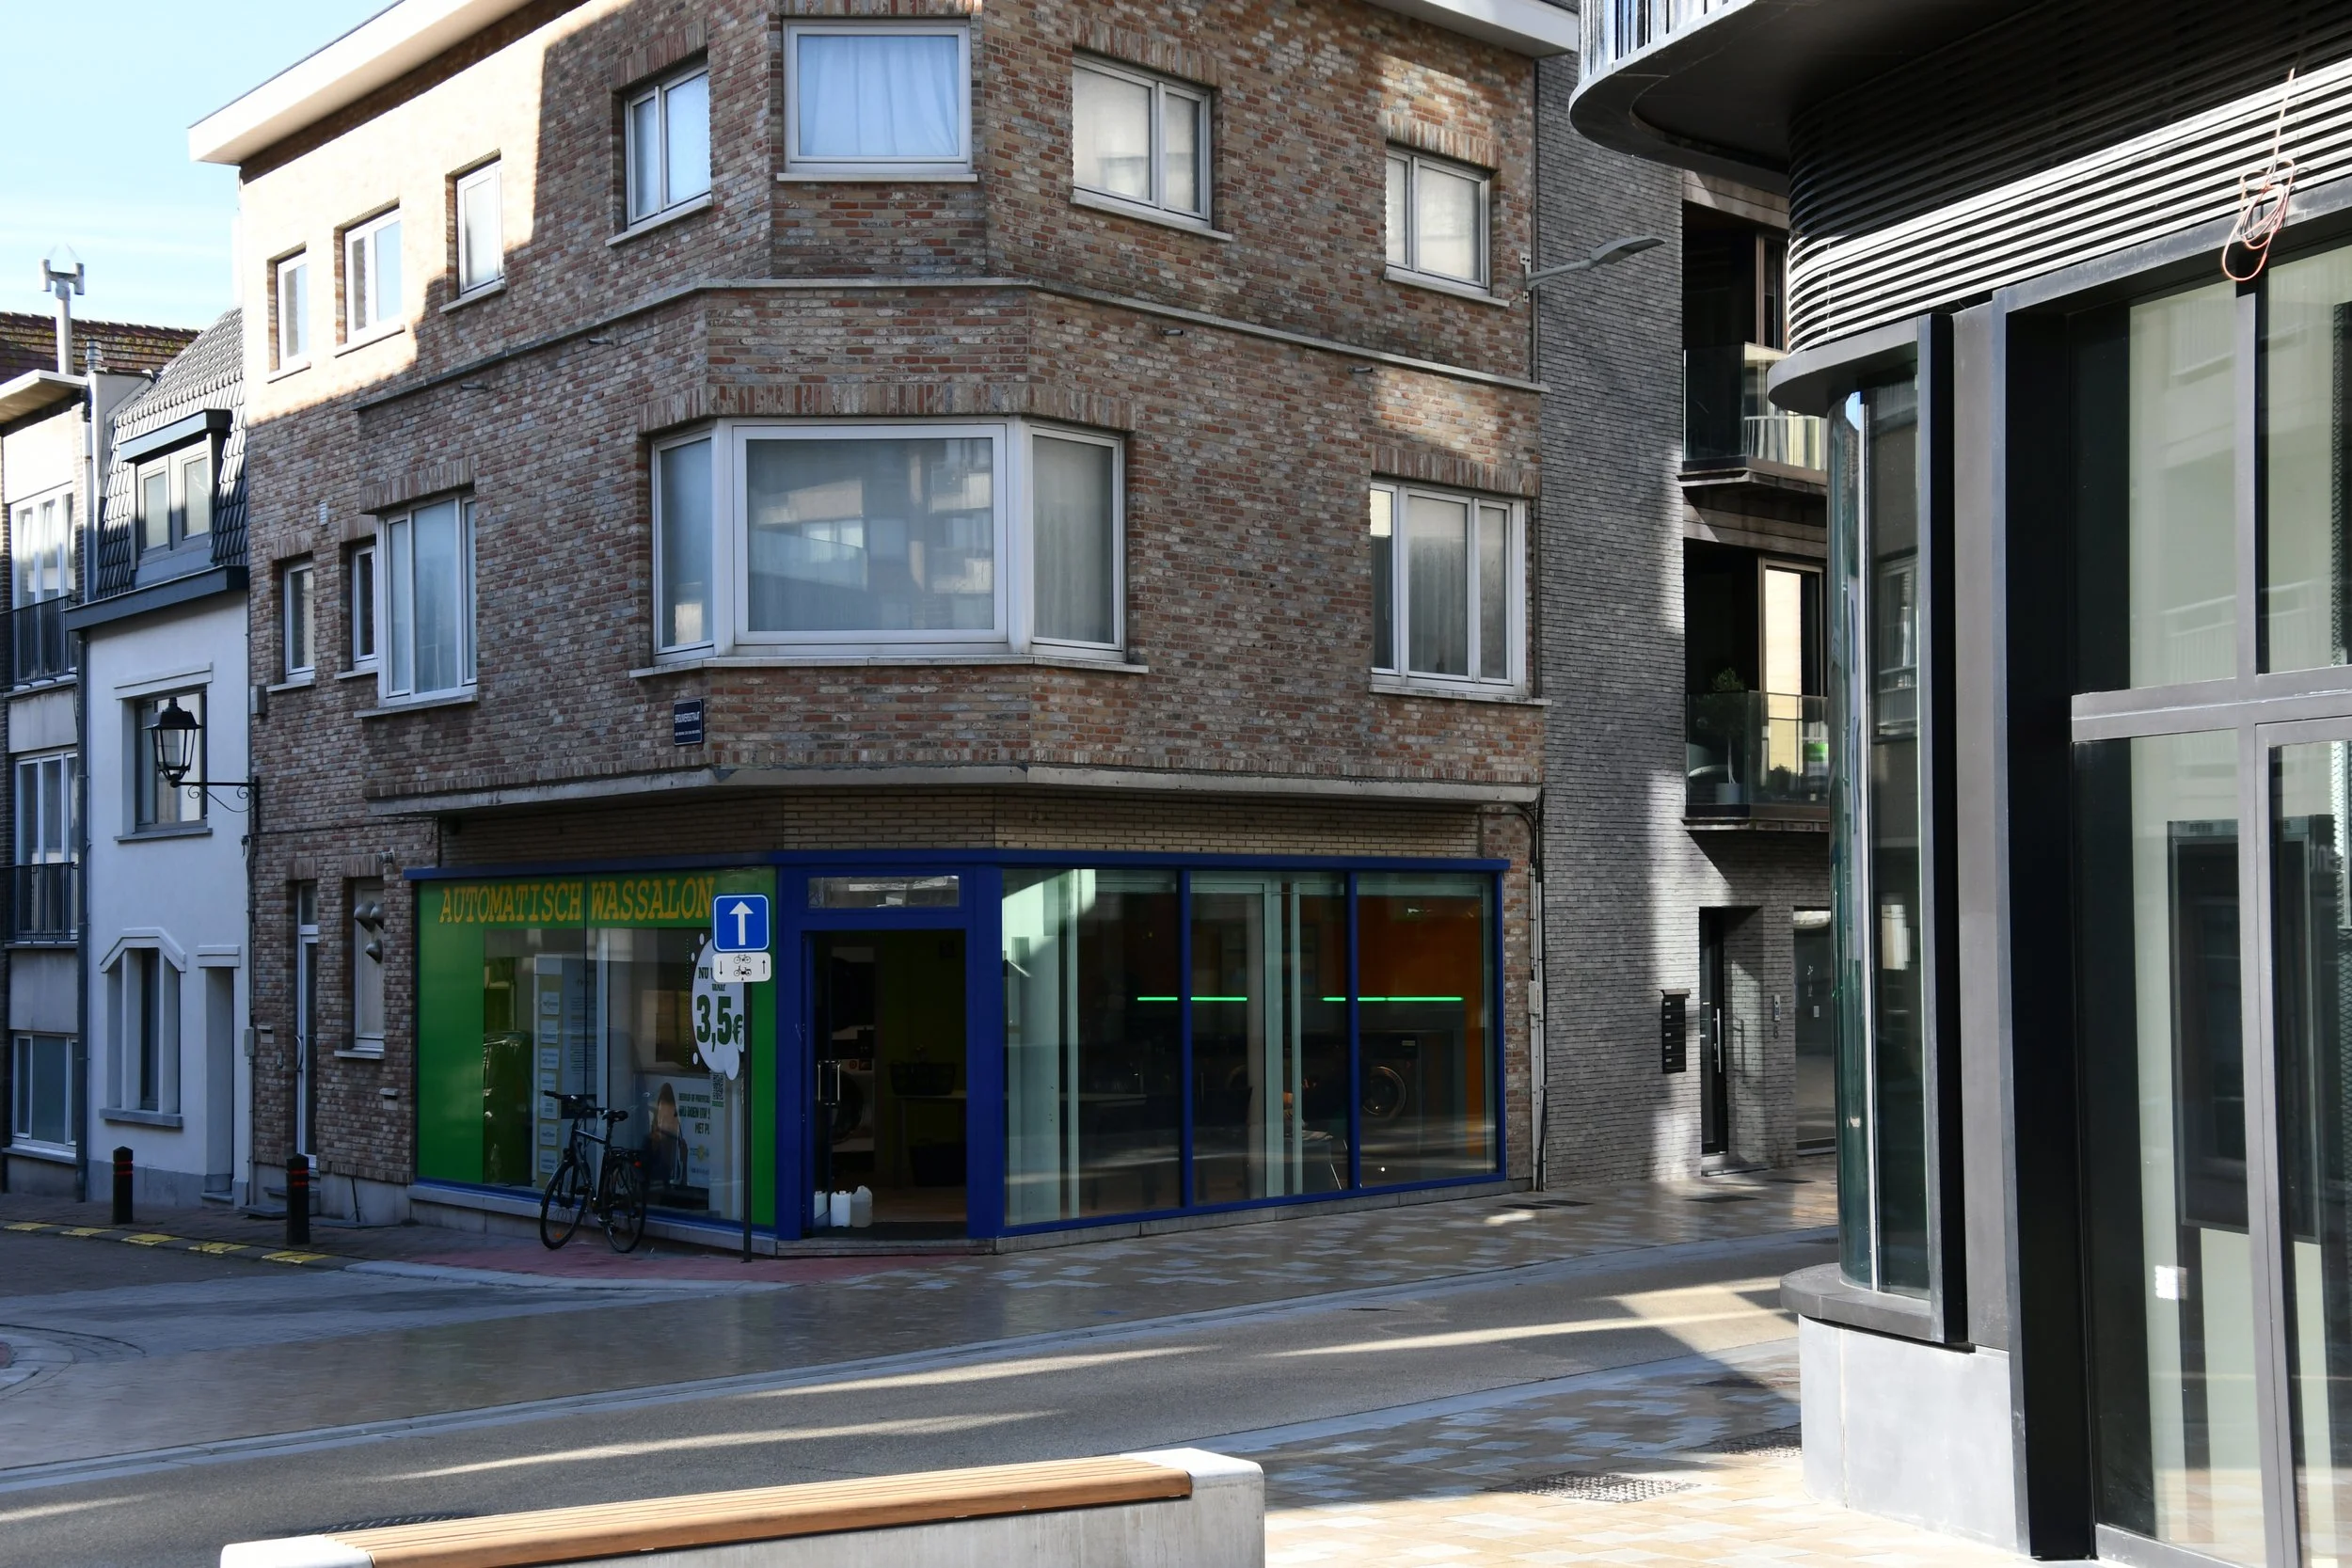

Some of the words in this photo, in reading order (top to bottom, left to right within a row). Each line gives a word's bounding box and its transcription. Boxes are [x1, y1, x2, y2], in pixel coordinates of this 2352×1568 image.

[438, 881, 583, 924] AUTOMATISCH
[591, 877, 715, 921] WASSALON
[698, 967, 708, 979] NU
